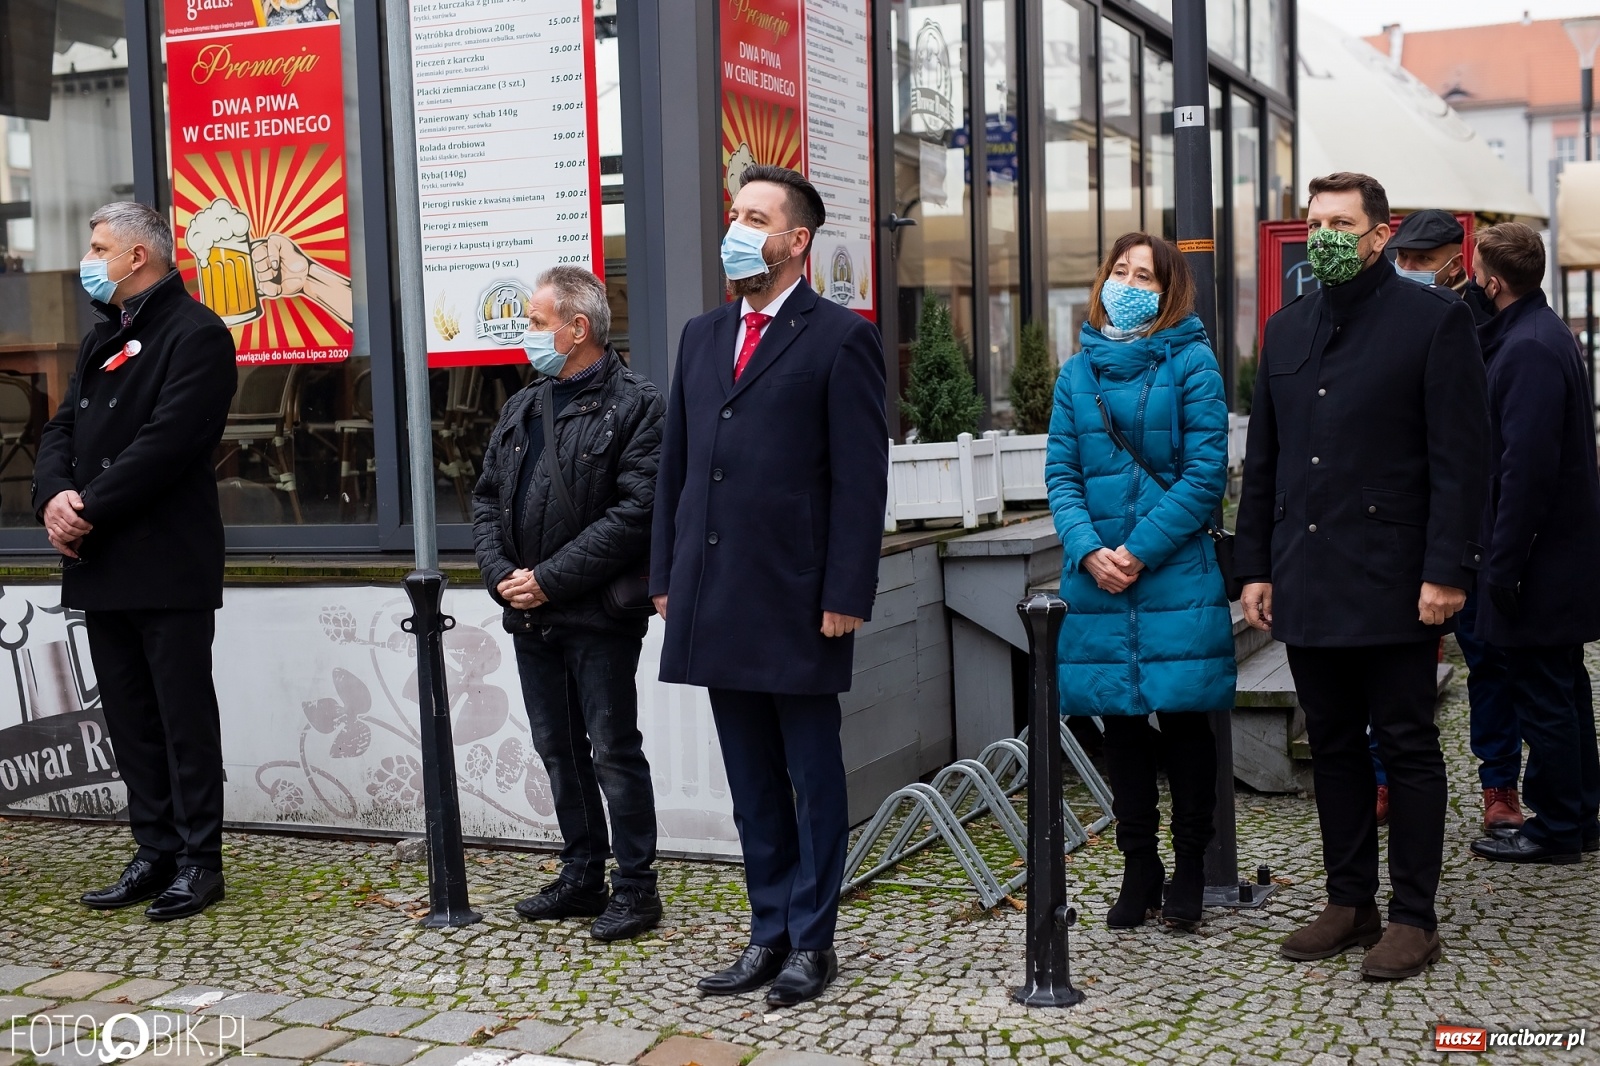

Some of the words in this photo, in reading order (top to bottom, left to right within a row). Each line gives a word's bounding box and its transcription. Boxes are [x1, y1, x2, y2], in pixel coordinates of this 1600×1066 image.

[414, 4, 431, 13] Filet
[438, 0, 474, 9] kurczaka
[415, 29, 453, 41] Wątróbka
[455, 25, 492, 37] drobiowa
[495, 23, 515, 32] 200g
[548, 16, 571, 26] 15.00
[573, 15, 580, 23] zł
[728, 0, 790, 45] Promocja
[416, 42, 443, 50] ziemniaki
[516, 32, 541, 40] surówka
[192, 44, 320, 87] Promocja
[416, 58, 446, 68] Pieczeń
[453, 54, 485, 64] karczku
[550, 44, 572, 53] 19.00
[574, 43, 581, 51] zł
[740, 41, 759, 63] DWA
[761, 48, 781, 70] PIWA
[464, 65, 489, 73] buraczki
[725, 61, 733, 79] W
[735, 65, 758, 87] CENIE
[760, 72, 795, 97] JEDNEGO
[417, 87, 441, 96] Placki
[443, 83, 496, 94] ziemniaczane
[498, 81, 506, 90] (3
[508, 79, 526, 88] szt.)
[551, 74, 573, 83] 15.00
[575, 73, 582, 81] zł
[212, 97, 252, 117] DWA
[256, 93, 299, 112] PIWA
[418, 114, 469, 124] Panierowany
[473, 110, 496, 119] schab
[498, 108, 518, 118] 140g
[552, 102, 574, 111] 19.00
[1181, 112, 1193, 122] 14
[182, 126, 199, 143] W
[203, 121, 250, 141] CENIE
[254, 114, 331, 138] JEDNEGO
[419, 143, 446, 152] Rolada
[448, 140, 485, 150] drobiowa
[553, 132, 576, 140] 19.00
[577, 130, 584, 138] zł
[421, 169, 466, 180] Ryba(140g)
[554, 161, 576, 169] 19.00
[578, 159, 586, 167] zł
[422, 200, 450, 209] Pierogi
[452, 198, 476, 207] ruskie
[484, 195, 510, 205] kwaśną
[512, 194, 545, 203] śmietaną
[555, 190, 578, 199] 19.00
[580, 189, 587, 197] zł
[423, 222, 450, 231] Pierogi
[458, 220, 488, 229] mięsem
[556, 212, 578, 221] 20.00
[580, 211, 588, 219] zł
[424, 243, 451, 252] Pierogi
[459, 240, 490, 250] kapustą
[496, 237, 533, 248] grzybami
[557, 234, 579, 243] 19.00
[581, 233, 588, 241] zł
[424, 263, 447, 272] Micha
[449, 262, 490, 272] pierogowa
[492, 260, 500, 269] (9
[502, 258, 519, 268] szt.)
[558, 255, 580, 263] 20.00
[582, 254, 589, 262] zł
[483, 322, 509, 333] Browar
[272, 350, 281, 360] do
[283, 350, 305, 359] końca
[306, 350, 326, 360] Lipca
[328, 349, 348, 358] 2020
[72, 787, 116, 814] 2013
